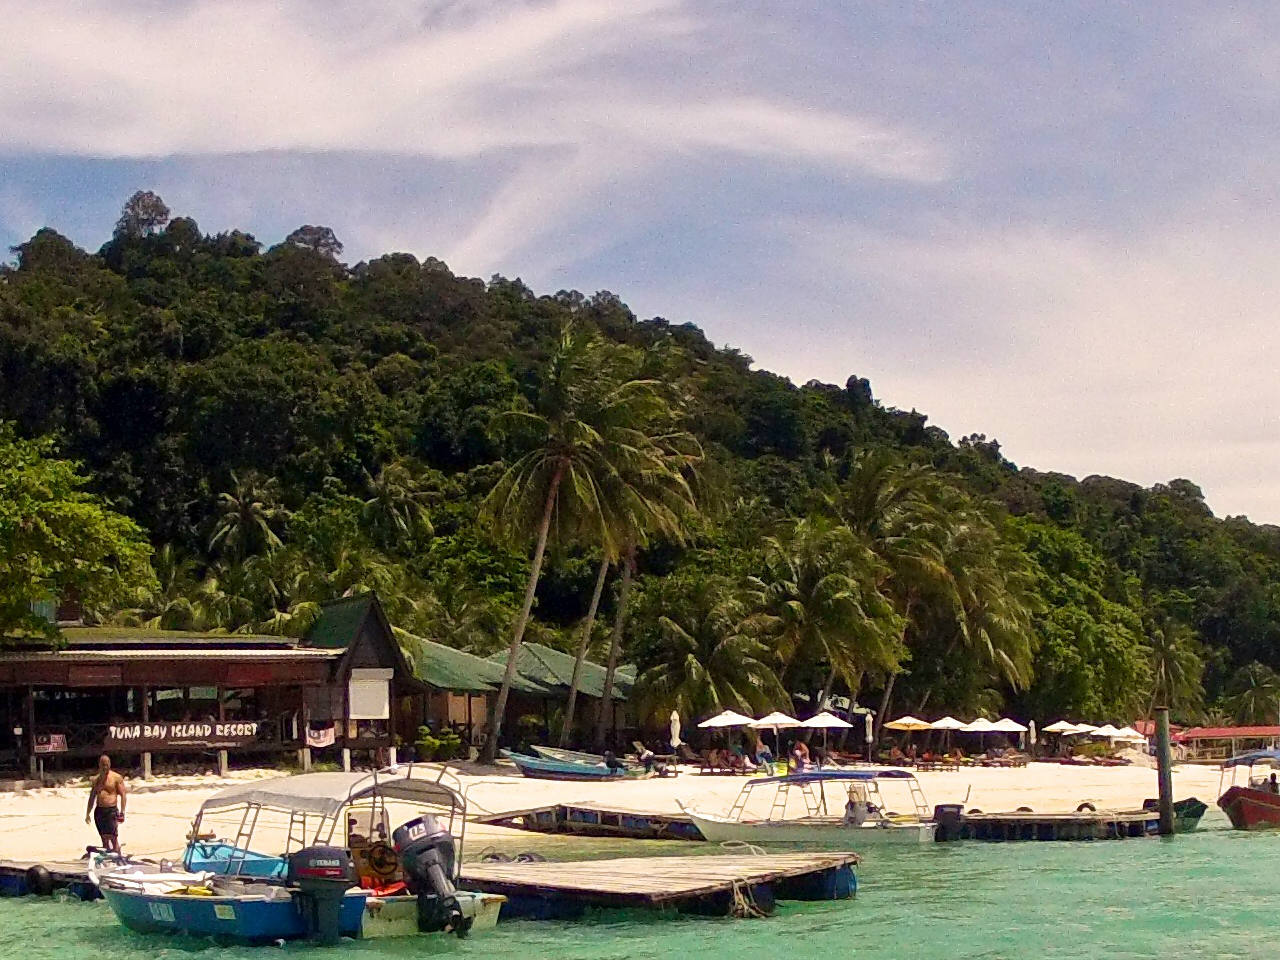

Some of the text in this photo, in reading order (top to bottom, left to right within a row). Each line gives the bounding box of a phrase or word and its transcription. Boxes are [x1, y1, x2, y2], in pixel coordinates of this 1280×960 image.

[109, 723, 257, 739] TUNA BAY ISLAND RESORT
